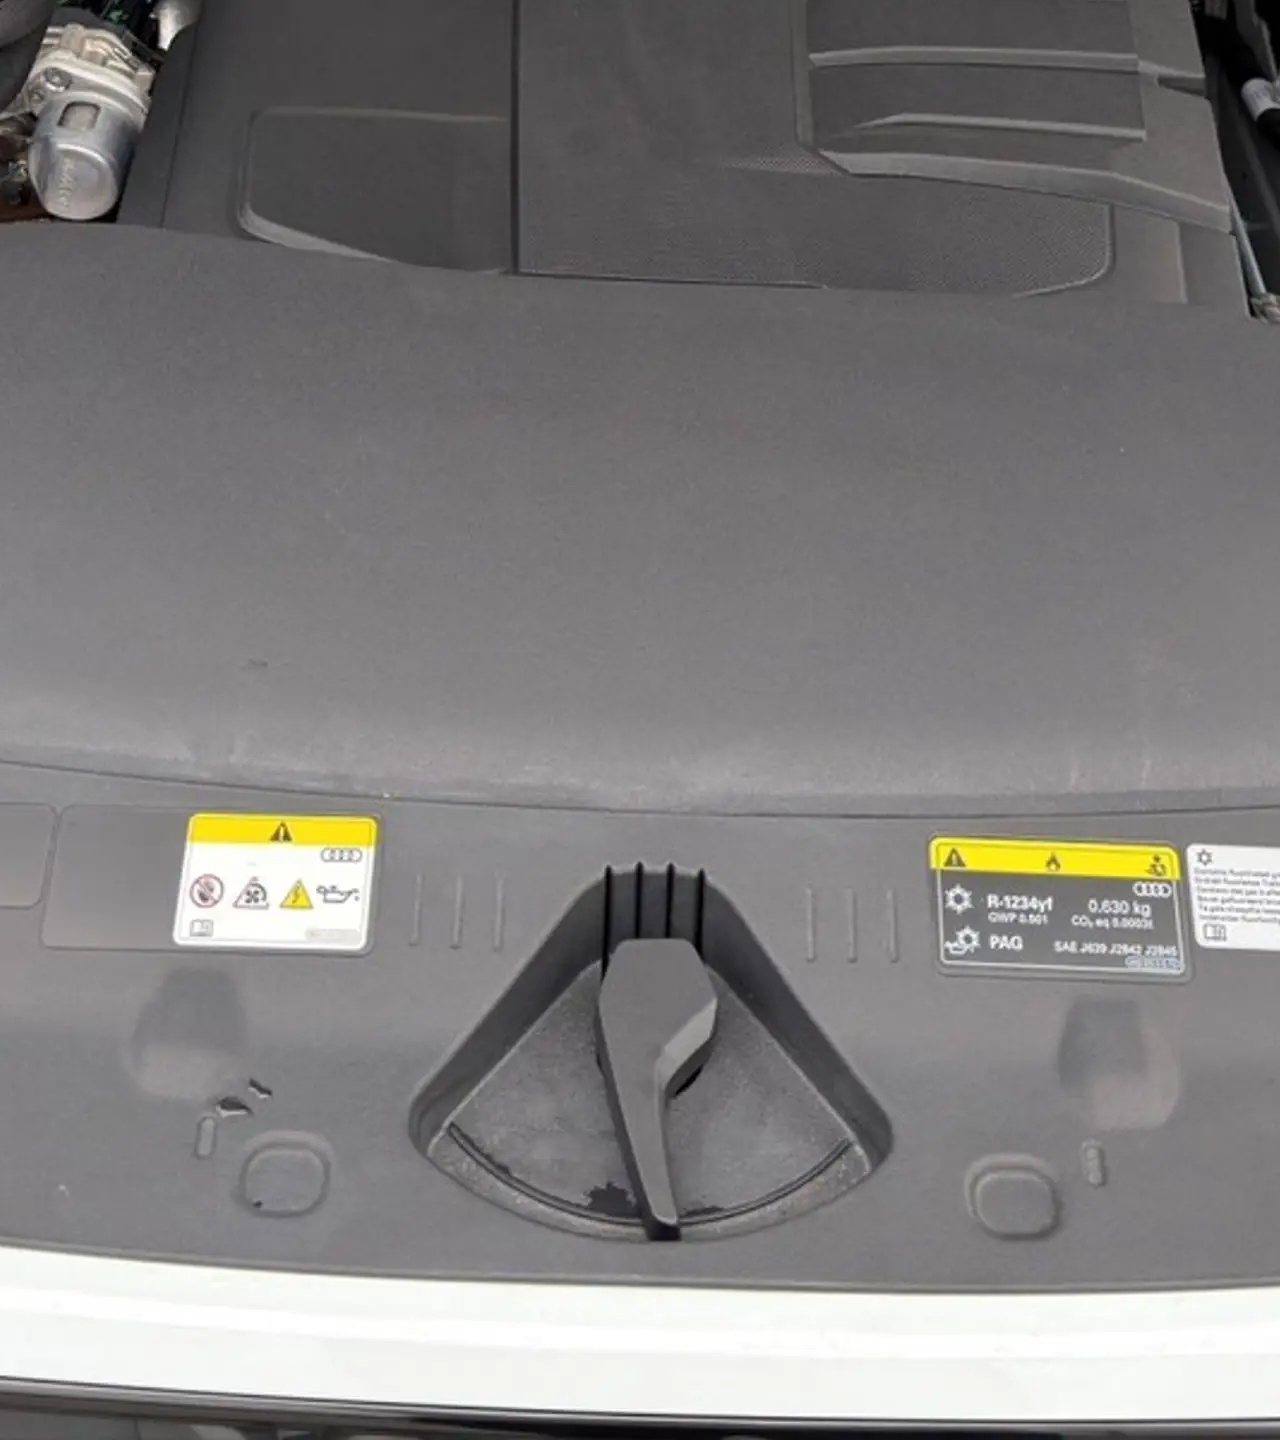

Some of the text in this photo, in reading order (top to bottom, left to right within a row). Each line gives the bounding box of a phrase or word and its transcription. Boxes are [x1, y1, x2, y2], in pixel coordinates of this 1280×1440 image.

[987, 894, 1053, 913] R-1234yf
[1132, 900, 1152, 918] kg
[989, 933, 1024, 951] PAG
[1053, 940, 1078, 953] SAE
